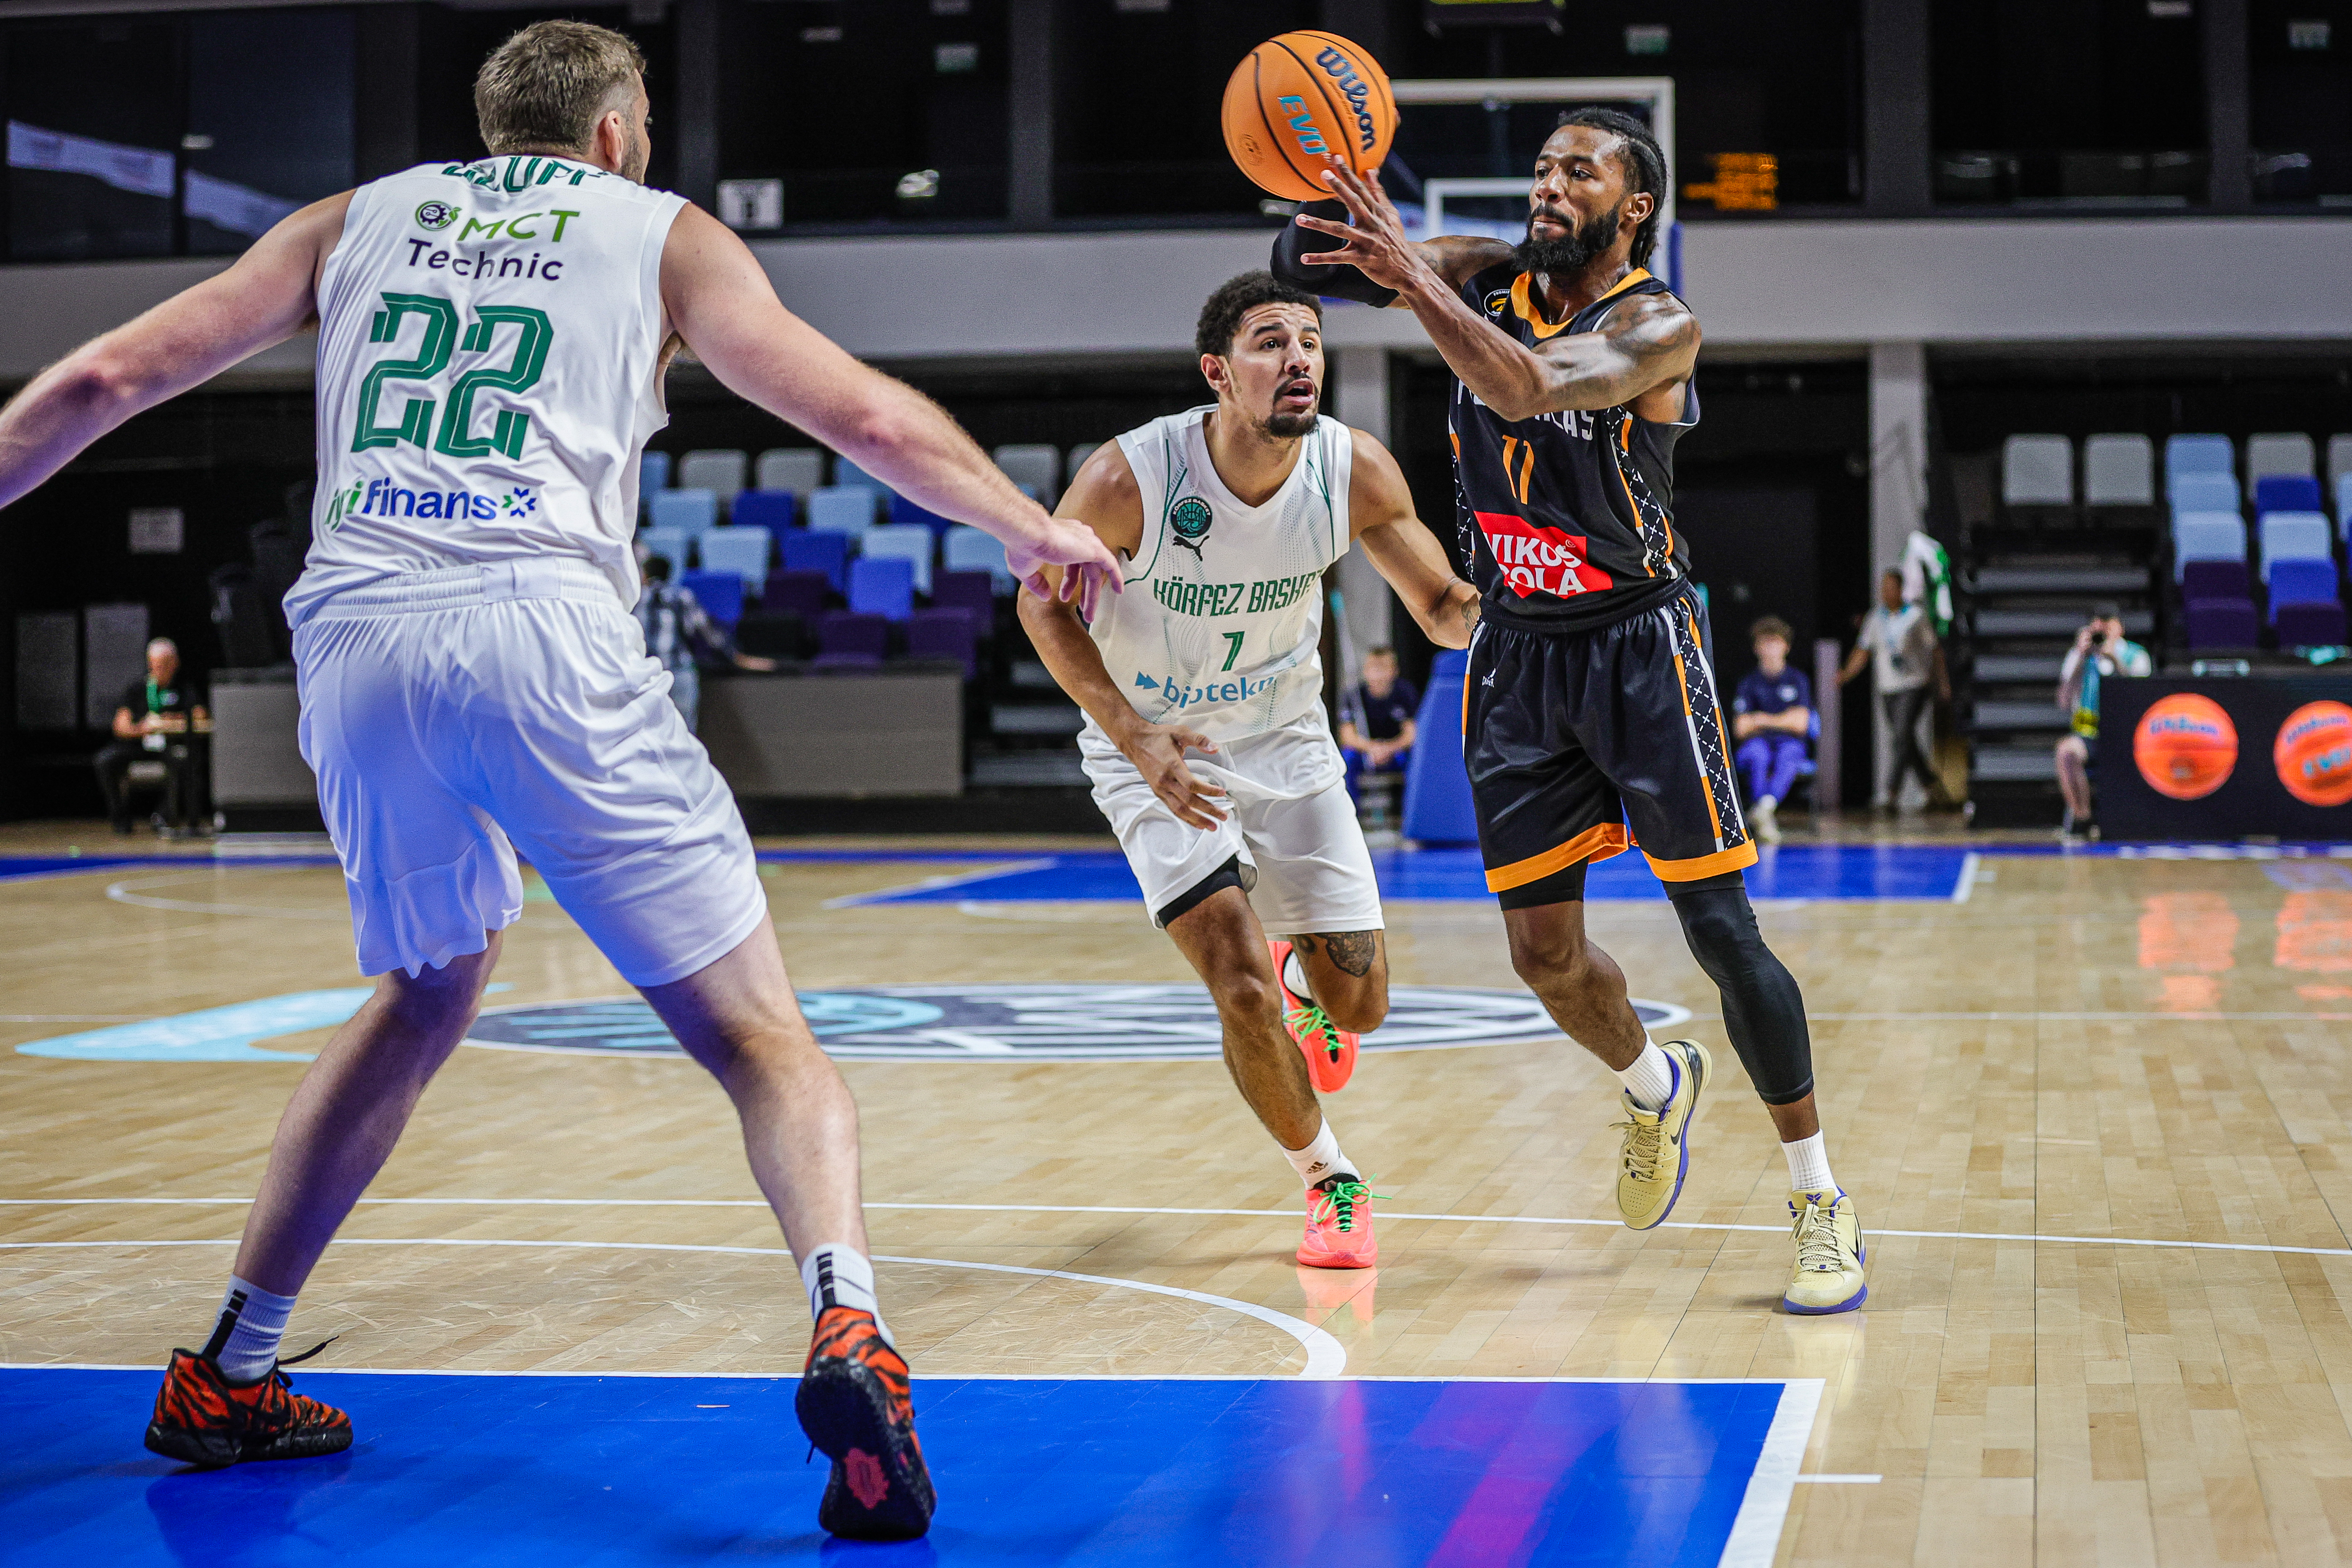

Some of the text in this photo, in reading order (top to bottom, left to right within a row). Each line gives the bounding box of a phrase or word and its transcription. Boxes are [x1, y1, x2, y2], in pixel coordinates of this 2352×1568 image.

[1316, 46, 1376, 153] Wilson
[456, 210, 580, 242] MCT
[408, 238, 563, 281] Technic
[351, 292, 554, 461] 22
[1502, 434, 1535, 505] 11
[1154, 576, 1245, 617] KÖRFEZ
[1221, 631, 1245, 672] 7
